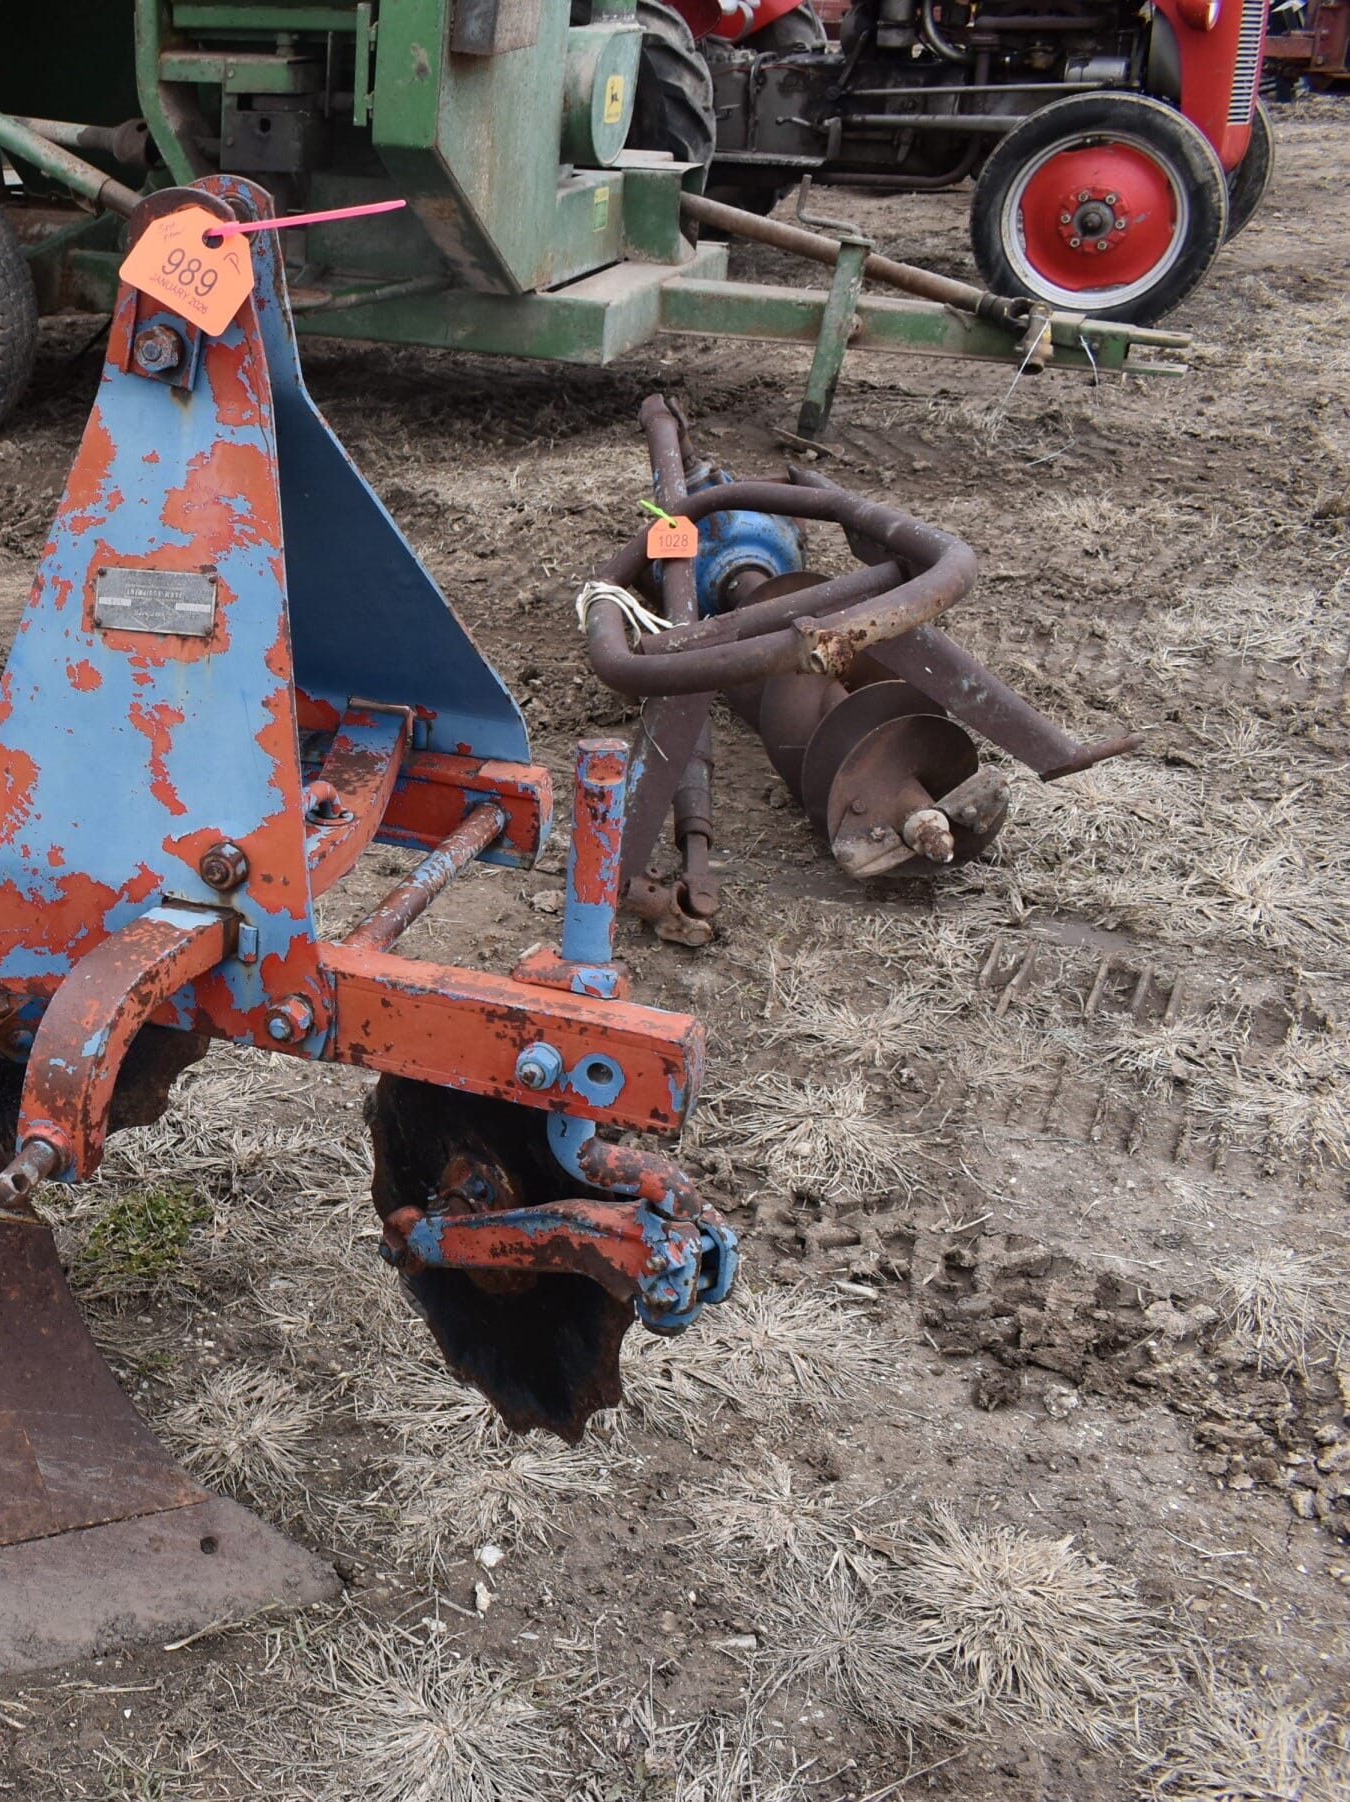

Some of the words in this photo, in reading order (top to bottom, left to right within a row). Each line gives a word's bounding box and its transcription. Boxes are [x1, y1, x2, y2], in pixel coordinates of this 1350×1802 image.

[162, 248, 219, 297] 989
[149, 273, 190, 299] JANUARY
[659, 534, 689, 548] 1028
